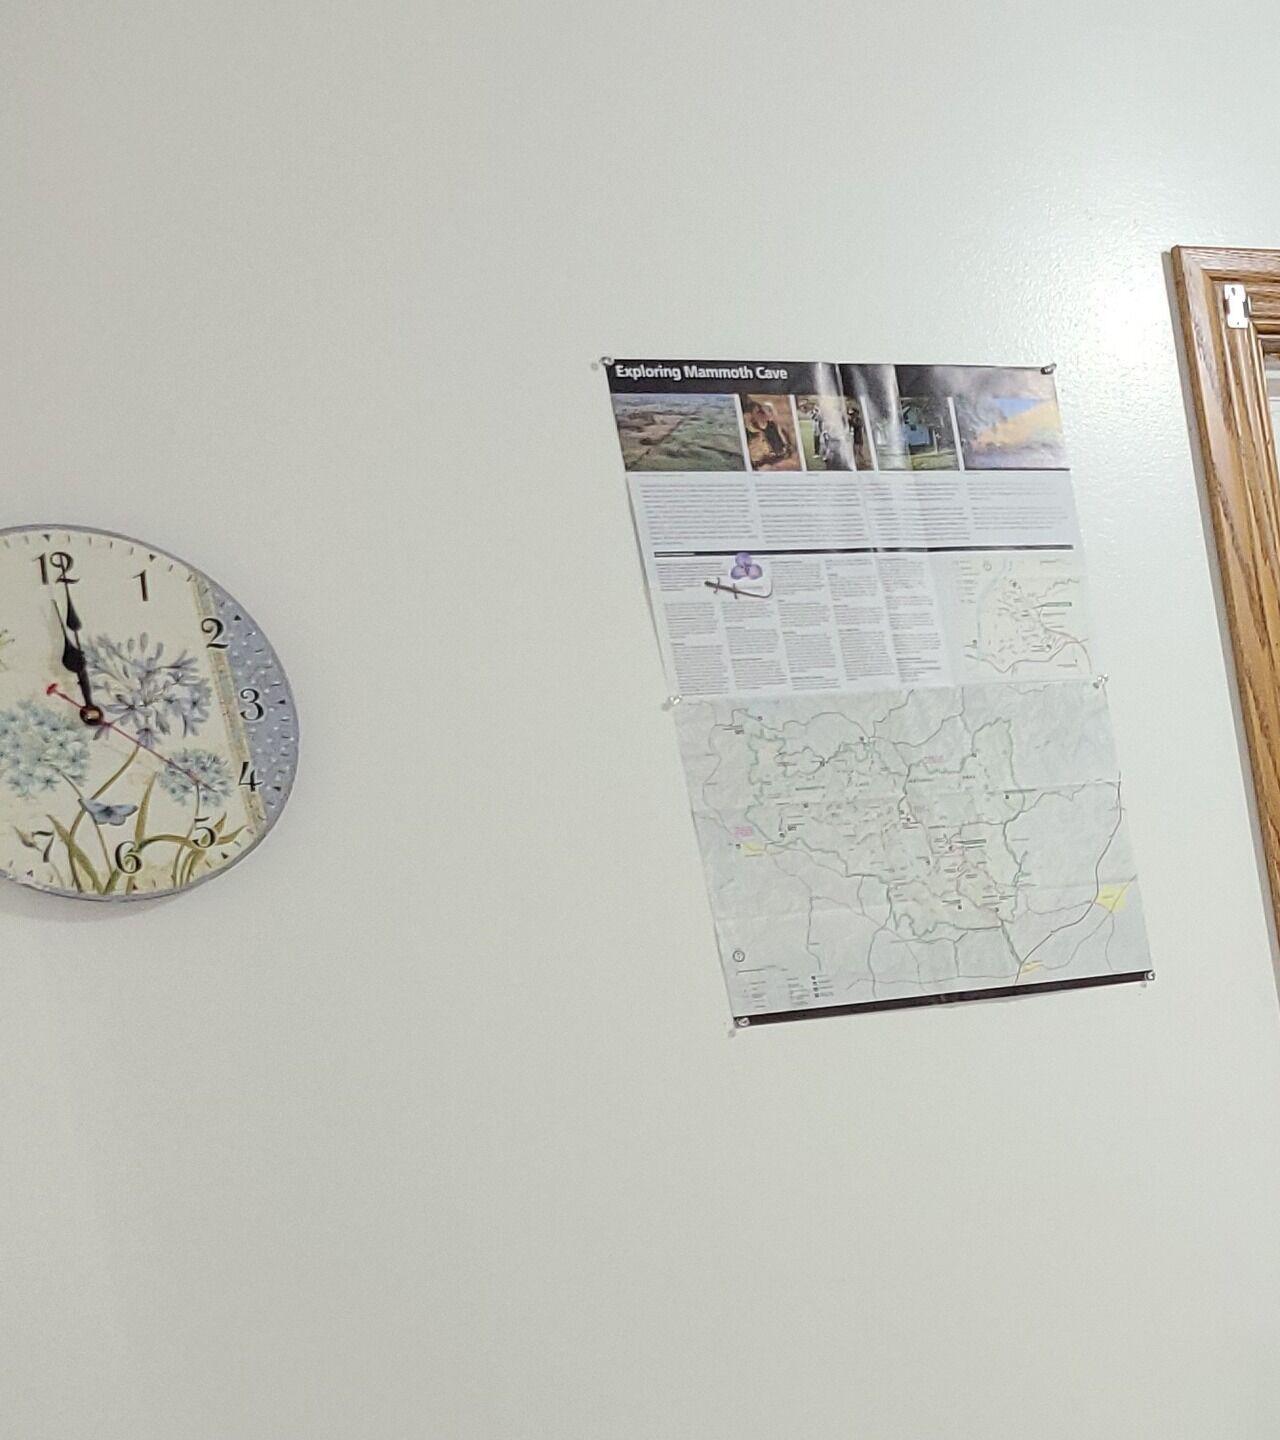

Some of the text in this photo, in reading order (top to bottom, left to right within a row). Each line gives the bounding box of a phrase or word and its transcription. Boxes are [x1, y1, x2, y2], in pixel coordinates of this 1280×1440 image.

[615, 365, 788, 381] Exploring Mammoth Cave
[33, 552, 80, 585] 12
[132, 569, 149, 602] 1
[200, 617, 229, 649] 2
[240, 688, 266, 721] 3
[238, 761, 262, 792] 4
[32, 831, 54, 863] 7
[193, 816, 216, 848] 5
[115, 841, 142, 874] 6
